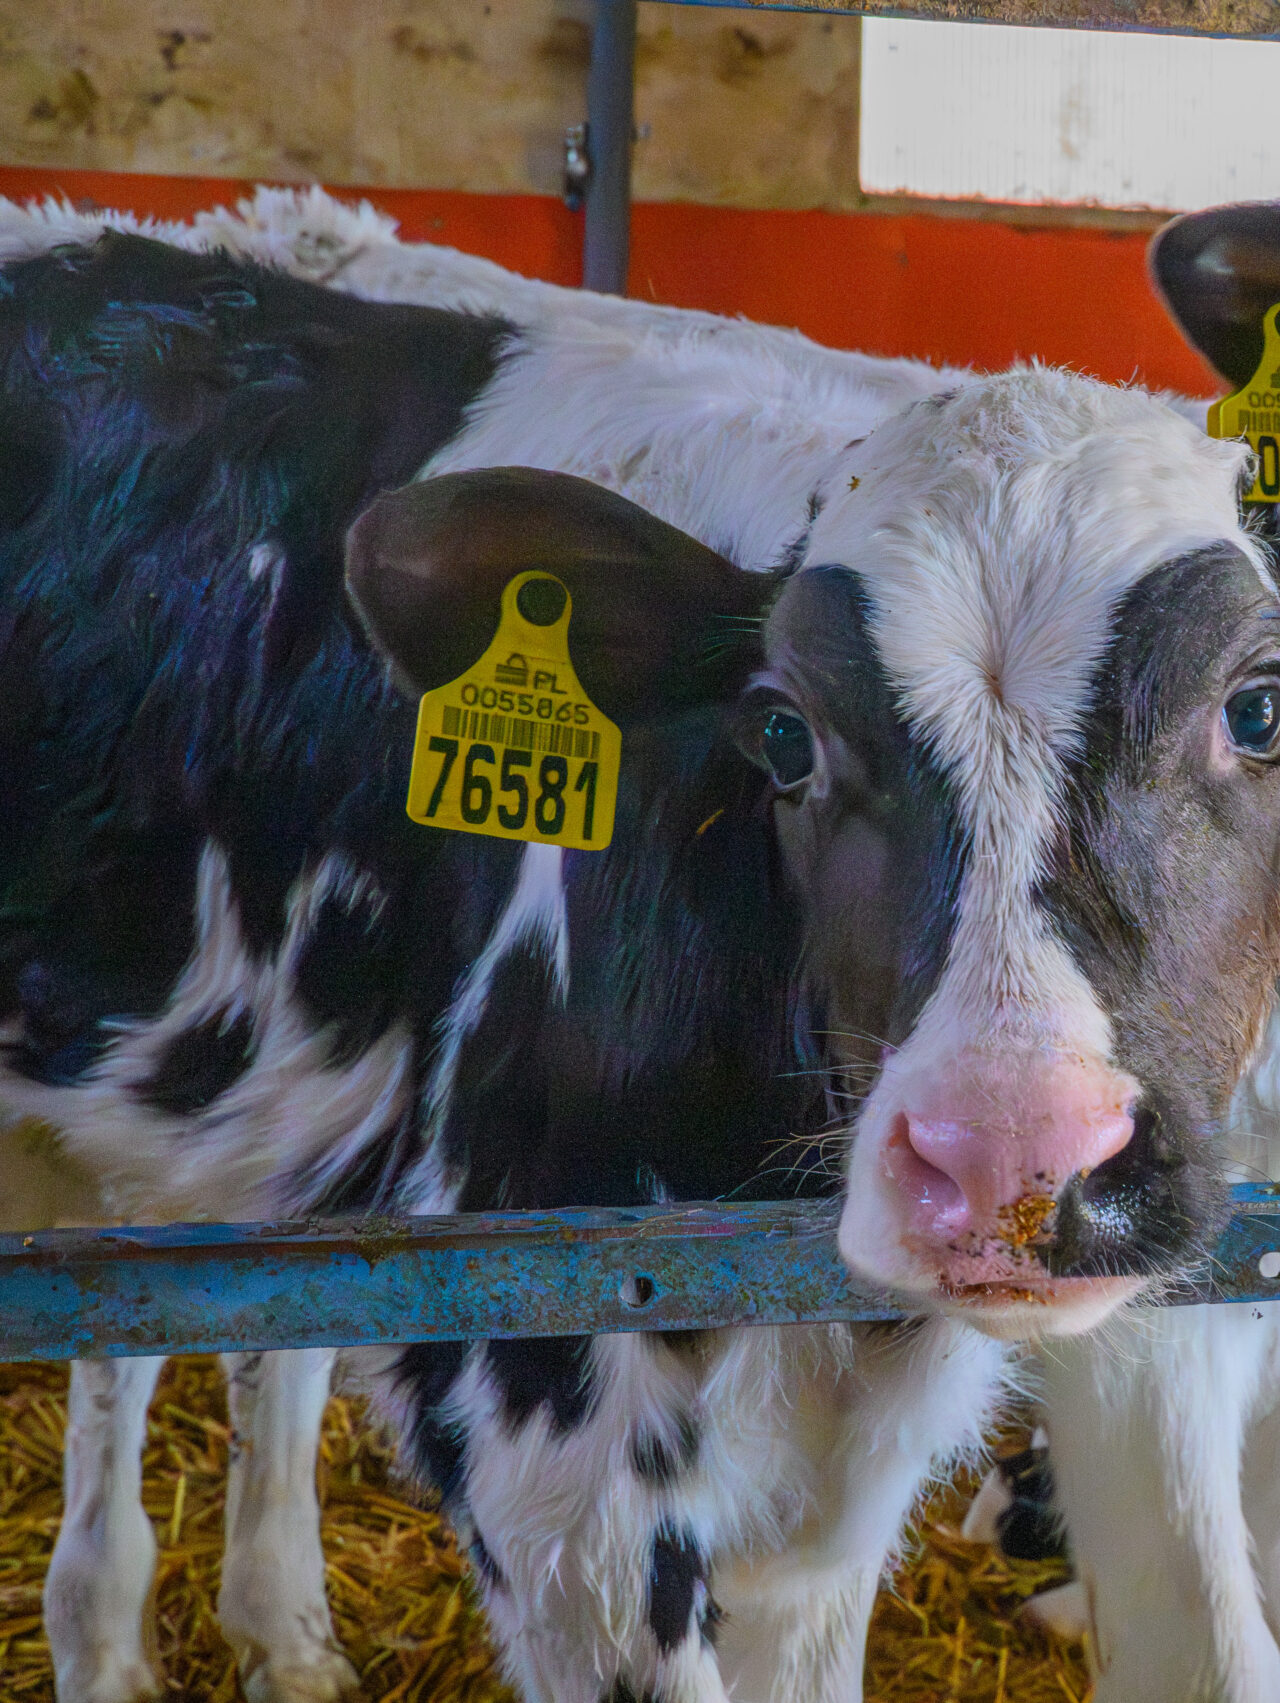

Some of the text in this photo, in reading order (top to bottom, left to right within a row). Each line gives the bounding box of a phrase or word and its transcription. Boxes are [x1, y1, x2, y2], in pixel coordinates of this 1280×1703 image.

[533, 670, 567, 695] PL
[461, 683, 590, 725] 0055865
[424, 735, 599, 841] 76581
